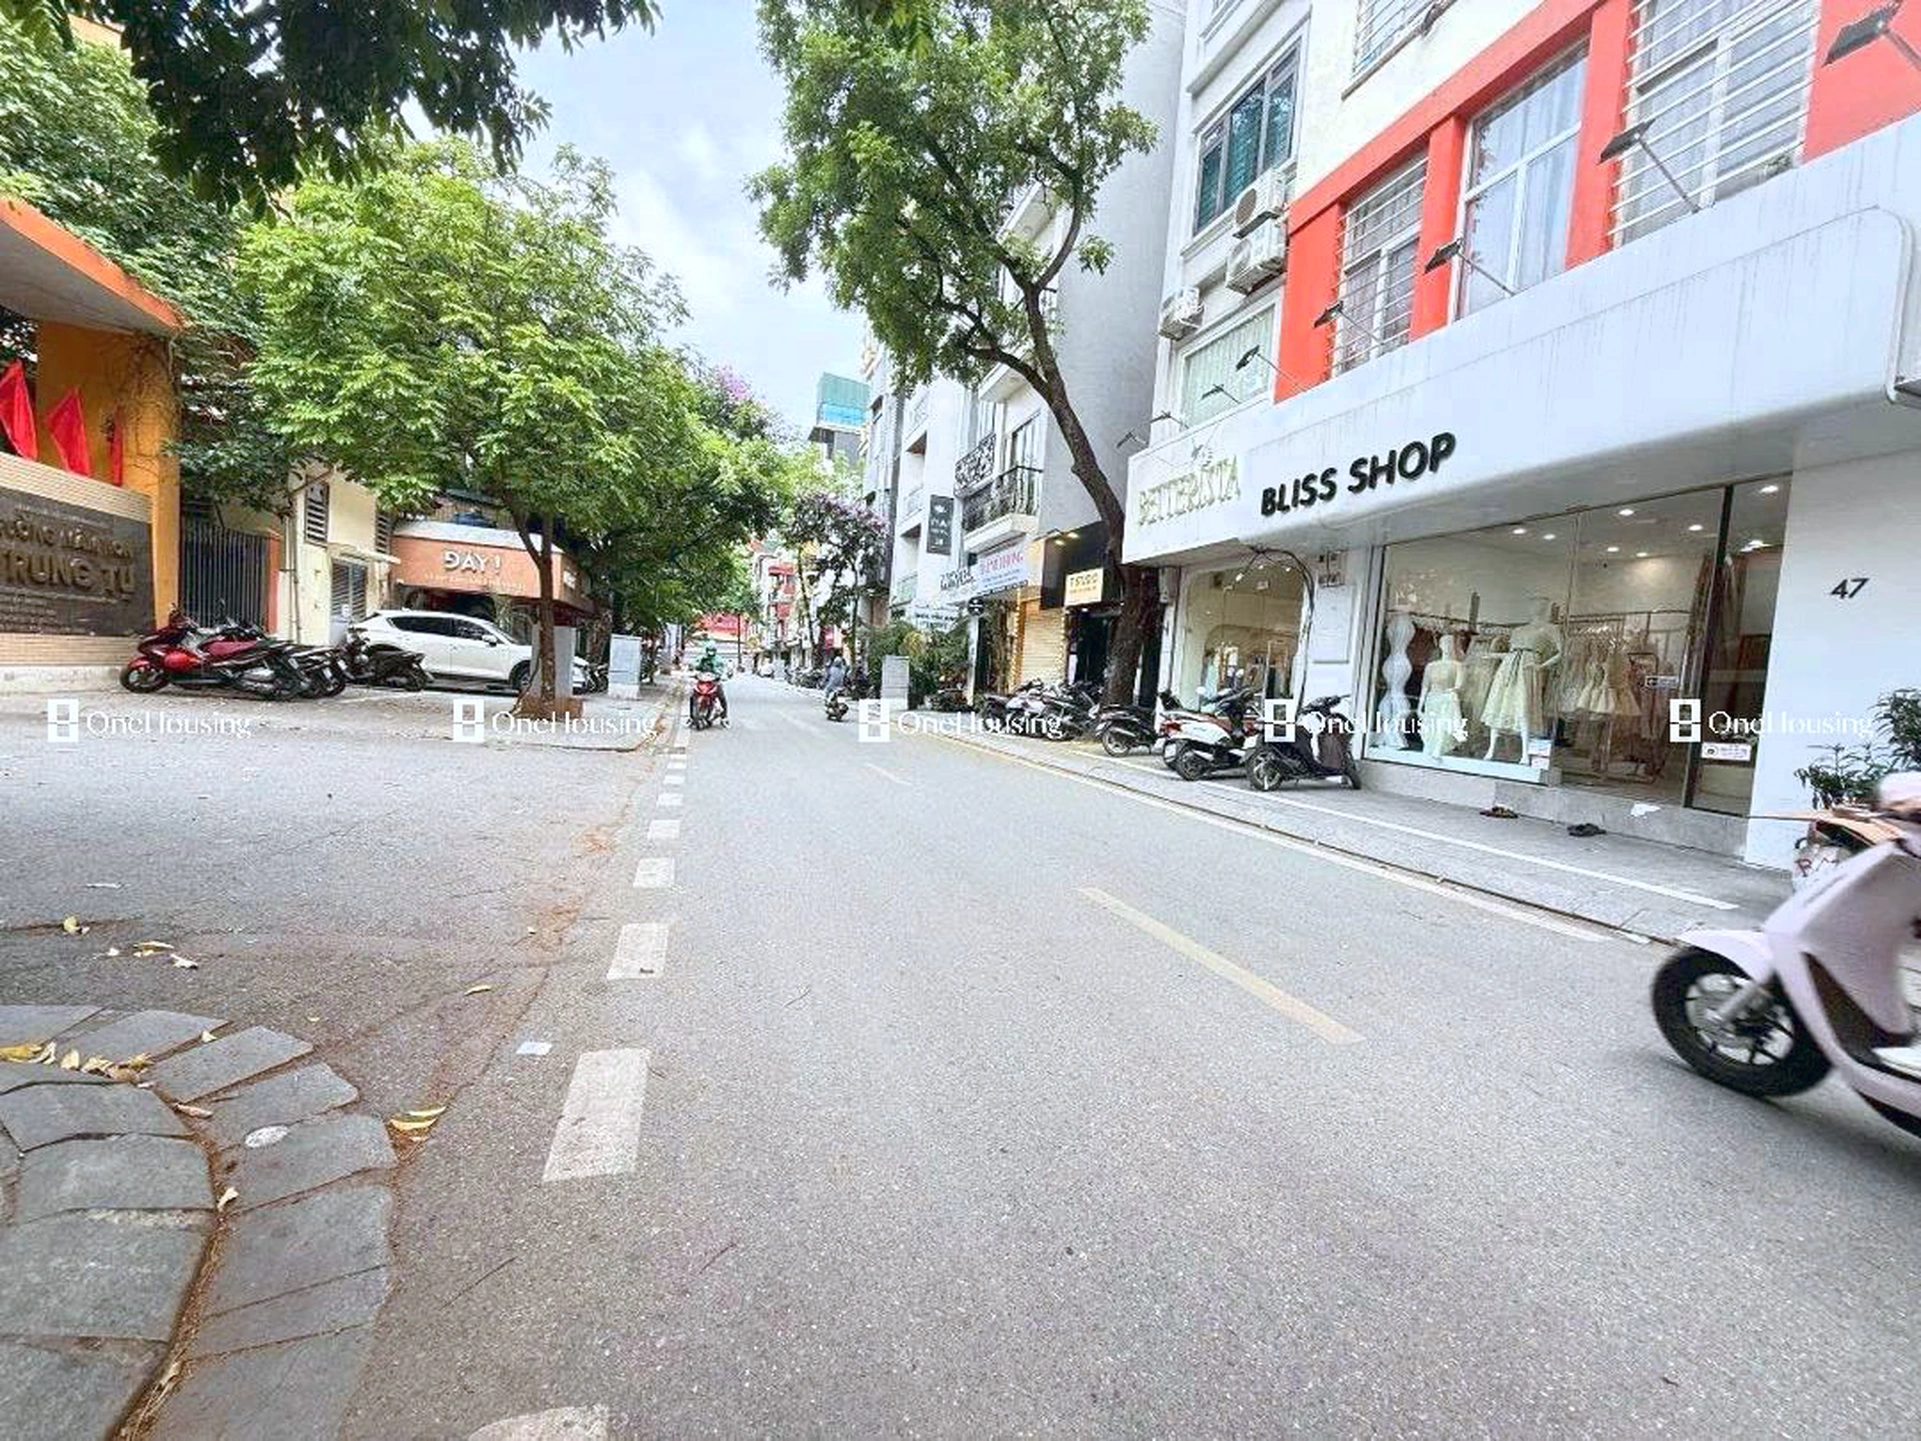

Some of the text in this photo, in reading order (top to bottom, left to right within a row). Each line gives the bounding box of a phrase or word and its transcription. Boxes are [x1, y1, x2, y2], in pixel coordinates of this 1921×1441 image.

[1261, 432, 1457, 517] BLISS SHOP
[1830, 577, 1870, 599] 47
